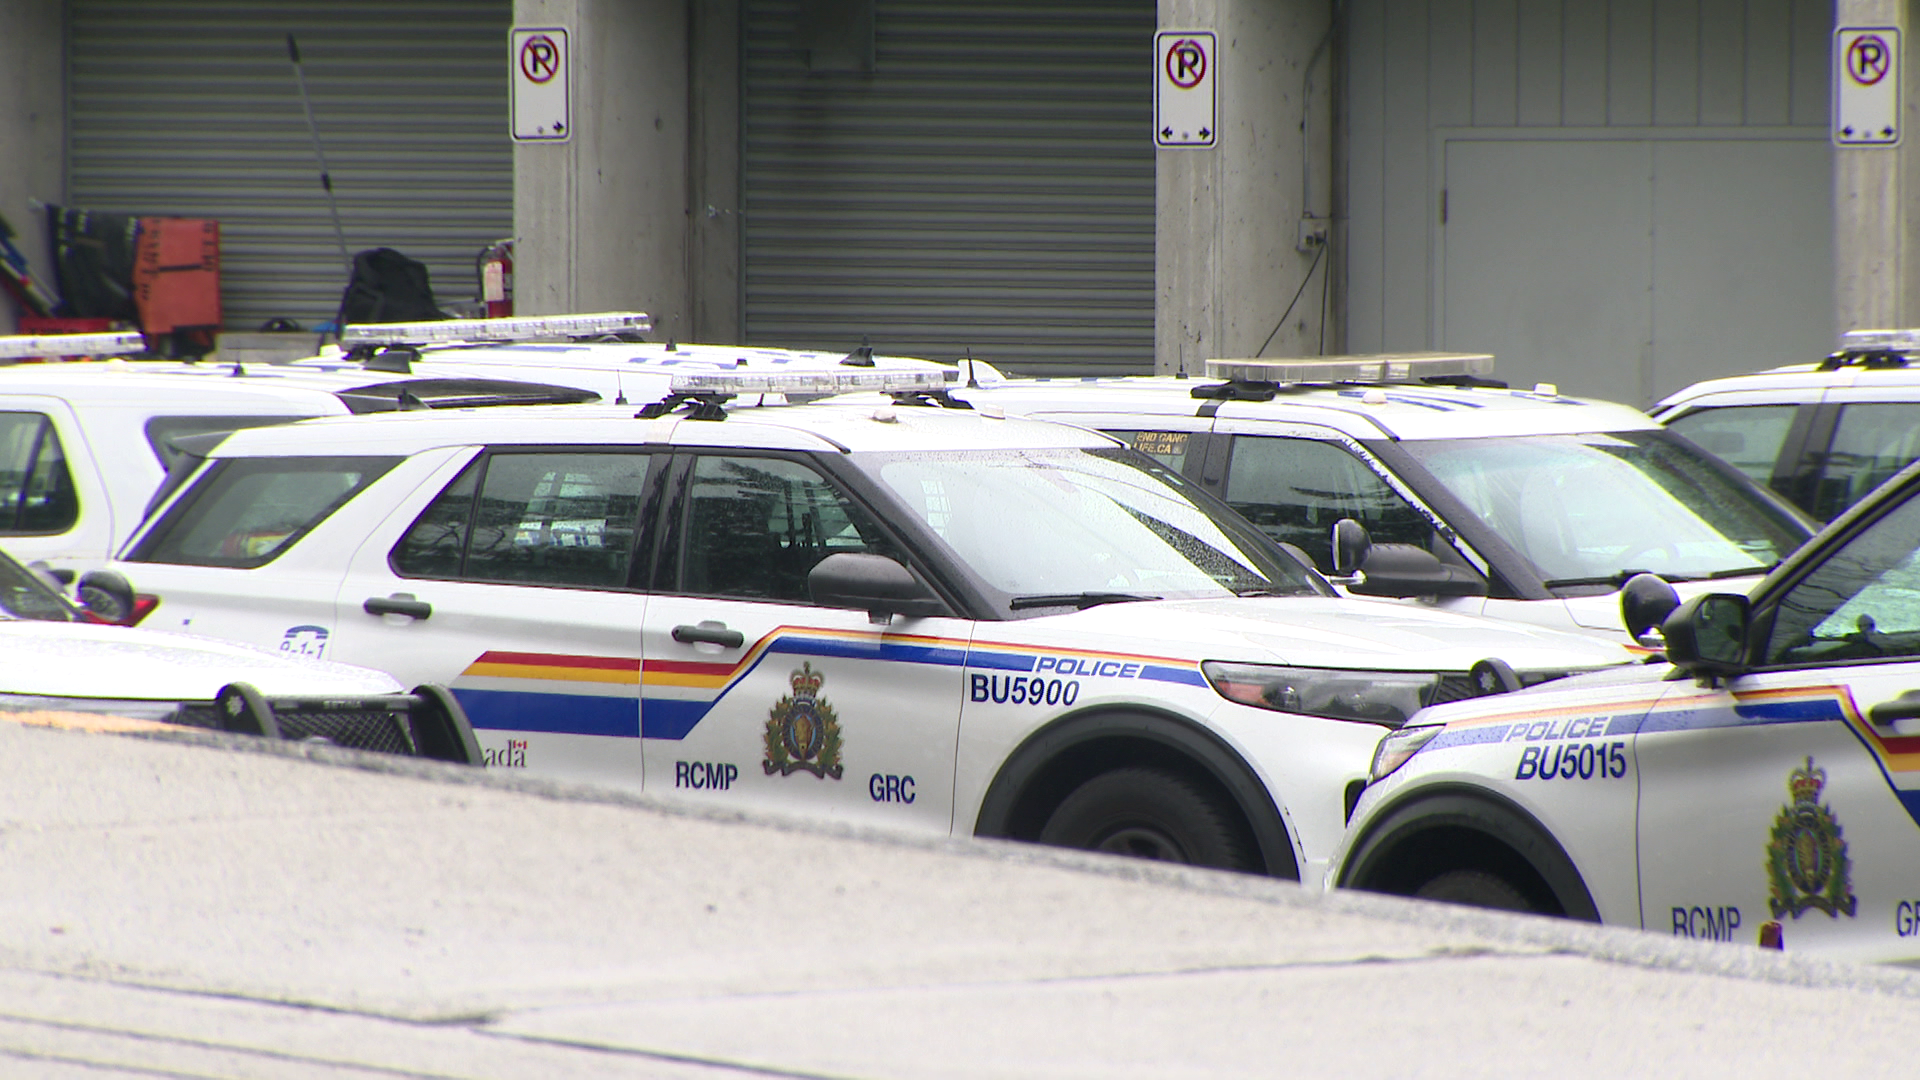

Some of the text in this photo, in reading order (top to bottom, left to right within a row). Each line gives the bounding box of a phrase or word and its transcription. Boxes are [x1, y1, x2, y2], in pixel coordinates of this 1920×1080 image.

[1137, 431, 1187, 443] END GANG
[1035, 656, 1141, 679] POLICE
[970, 673, 1080, 706] BU5900
[1505, 716, 1609, 742] POLICE
[675, 760, 739, 791] RCMP
[1515, 742, 1627, 780] BU5015
[868, 772, 917, 804] GRC
[1671, 905, 1741, 943] RCMP
